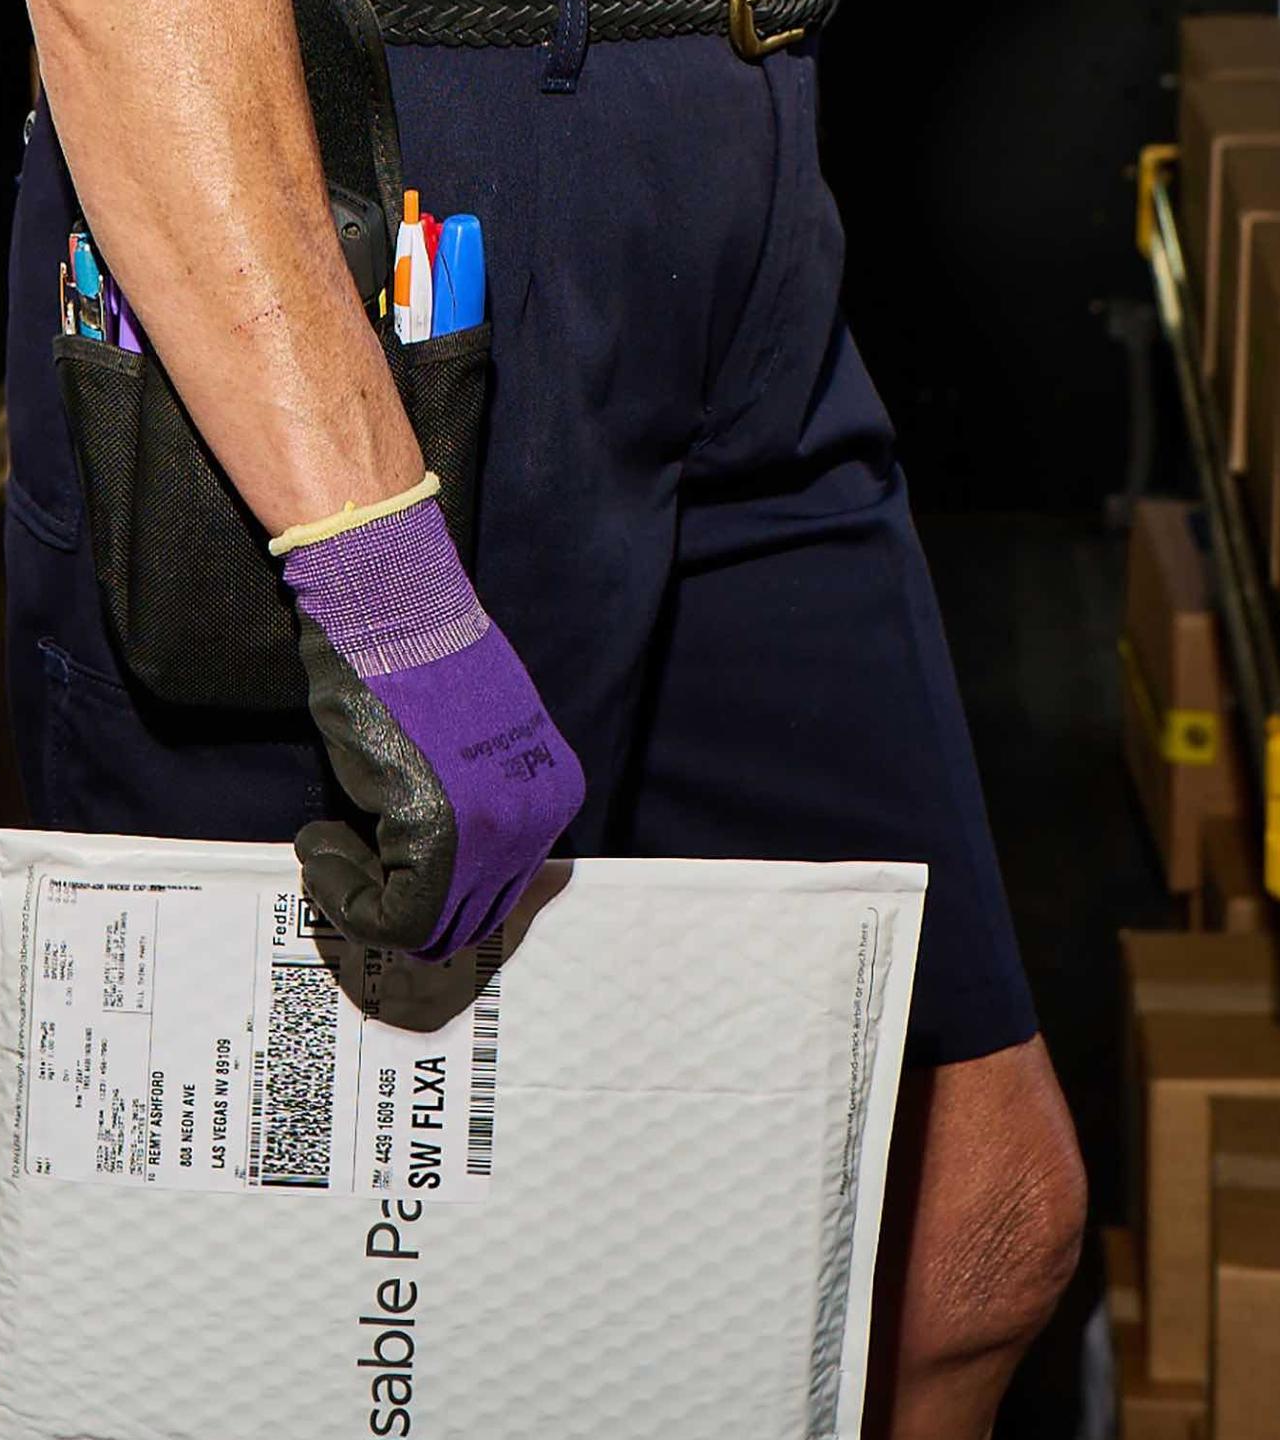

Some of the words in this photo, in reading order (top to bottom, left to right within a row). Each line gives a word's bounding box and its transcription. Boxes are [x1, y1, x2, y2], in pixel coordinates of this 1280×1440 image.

[273, 893, 288, 947] FedEx
[366, 963, 381, 976] 13
[857, 949, 866, 984] pouch
[18, 964, 28, 1007] shipping
[855, 987, 863, 998] or
[364, 999, 380, 1022] TUE
[215, 1038, 231, 1075] 89109
[183, 1083, 195, 1107] AVE
[214, 1078, 229, 1096] NV
[380, 1068, 396, 1098] 4365
[412, 1056, 446, 1129] FLXA
[150, 1071, 165, 1127] ASHFORD
[182, 1110, 194, 1143] NEON
[213, 1100, 228, 1141] VEGAS
[378, 1101, 395, 1130] 1609
[148, 1130, 163, 1165] REMY
[181, 1147, 193, 1167] 808
[212, 1146, 225, 1169] LAS
[375, 1134, 394, 1164] 4439
[407, 1140, 442, 1189] SW
